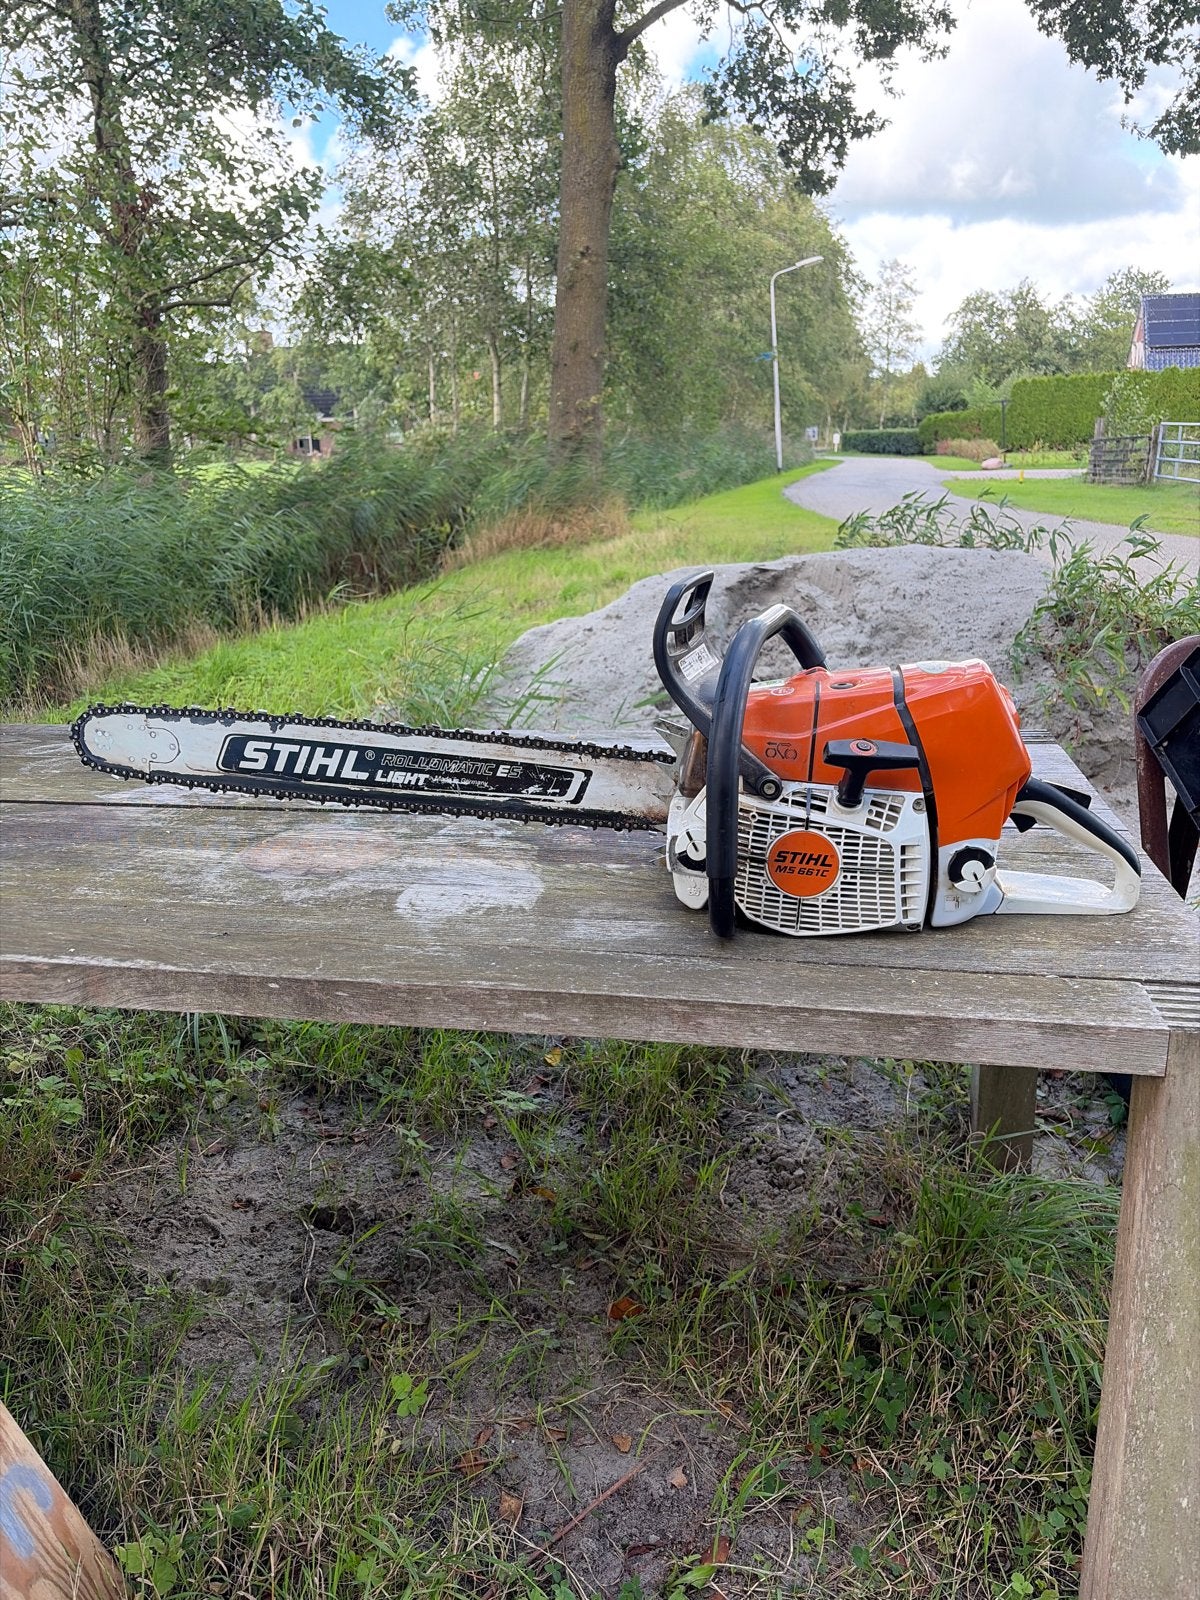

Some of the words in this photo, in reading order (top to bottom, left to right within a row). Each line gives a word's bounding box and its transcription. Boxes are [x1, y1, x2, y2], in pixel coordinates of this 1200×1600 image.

[381, 753, 495, 776] ROLLOMATIC
[496, 764, 522, 779] ES
[375, 769, 430, 786] LIGHT
[774, 850, 833, 868] STIHL
[775, 865, 796, 874] MS
